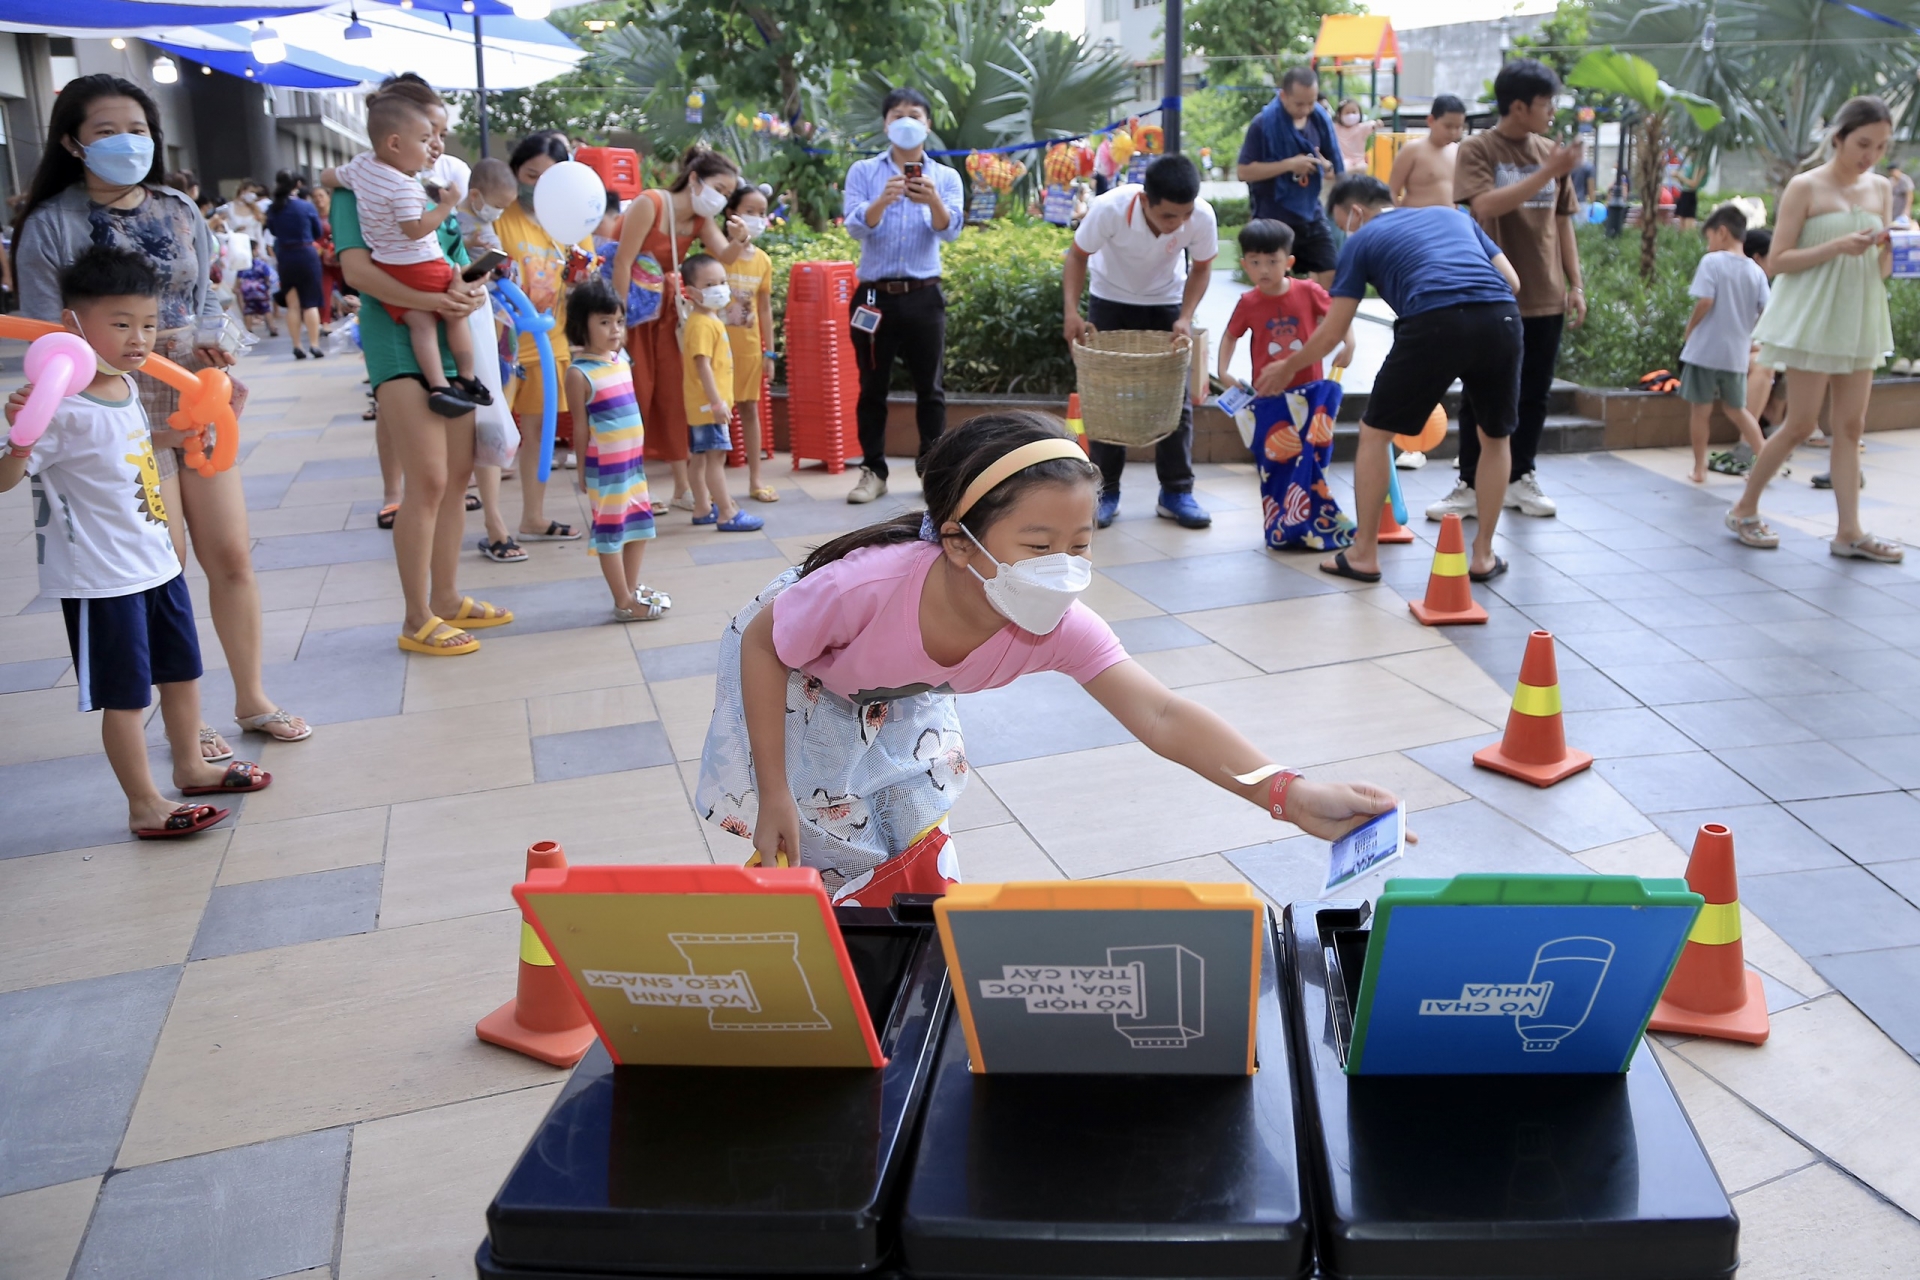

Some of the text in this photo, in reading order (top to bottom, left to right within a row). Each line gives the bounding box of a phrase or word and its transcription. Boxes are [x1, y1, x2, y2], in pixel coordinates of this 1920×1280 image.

[591, 973, 738, 990] KẸO, SNACK
[1010, 968, 1131, 983] TRÁI CÂY
[989, 983, 1132, 998] SỮA, NƯỚC
[1467, 984, 1543, 998] NHỰA
[633, 991, 747, 1008] VỎ BÁNH
[1033, 997, 1133, 1013] VỎ HỘP
[1426, 1002, 1536, 1016] VỎ CHAI
